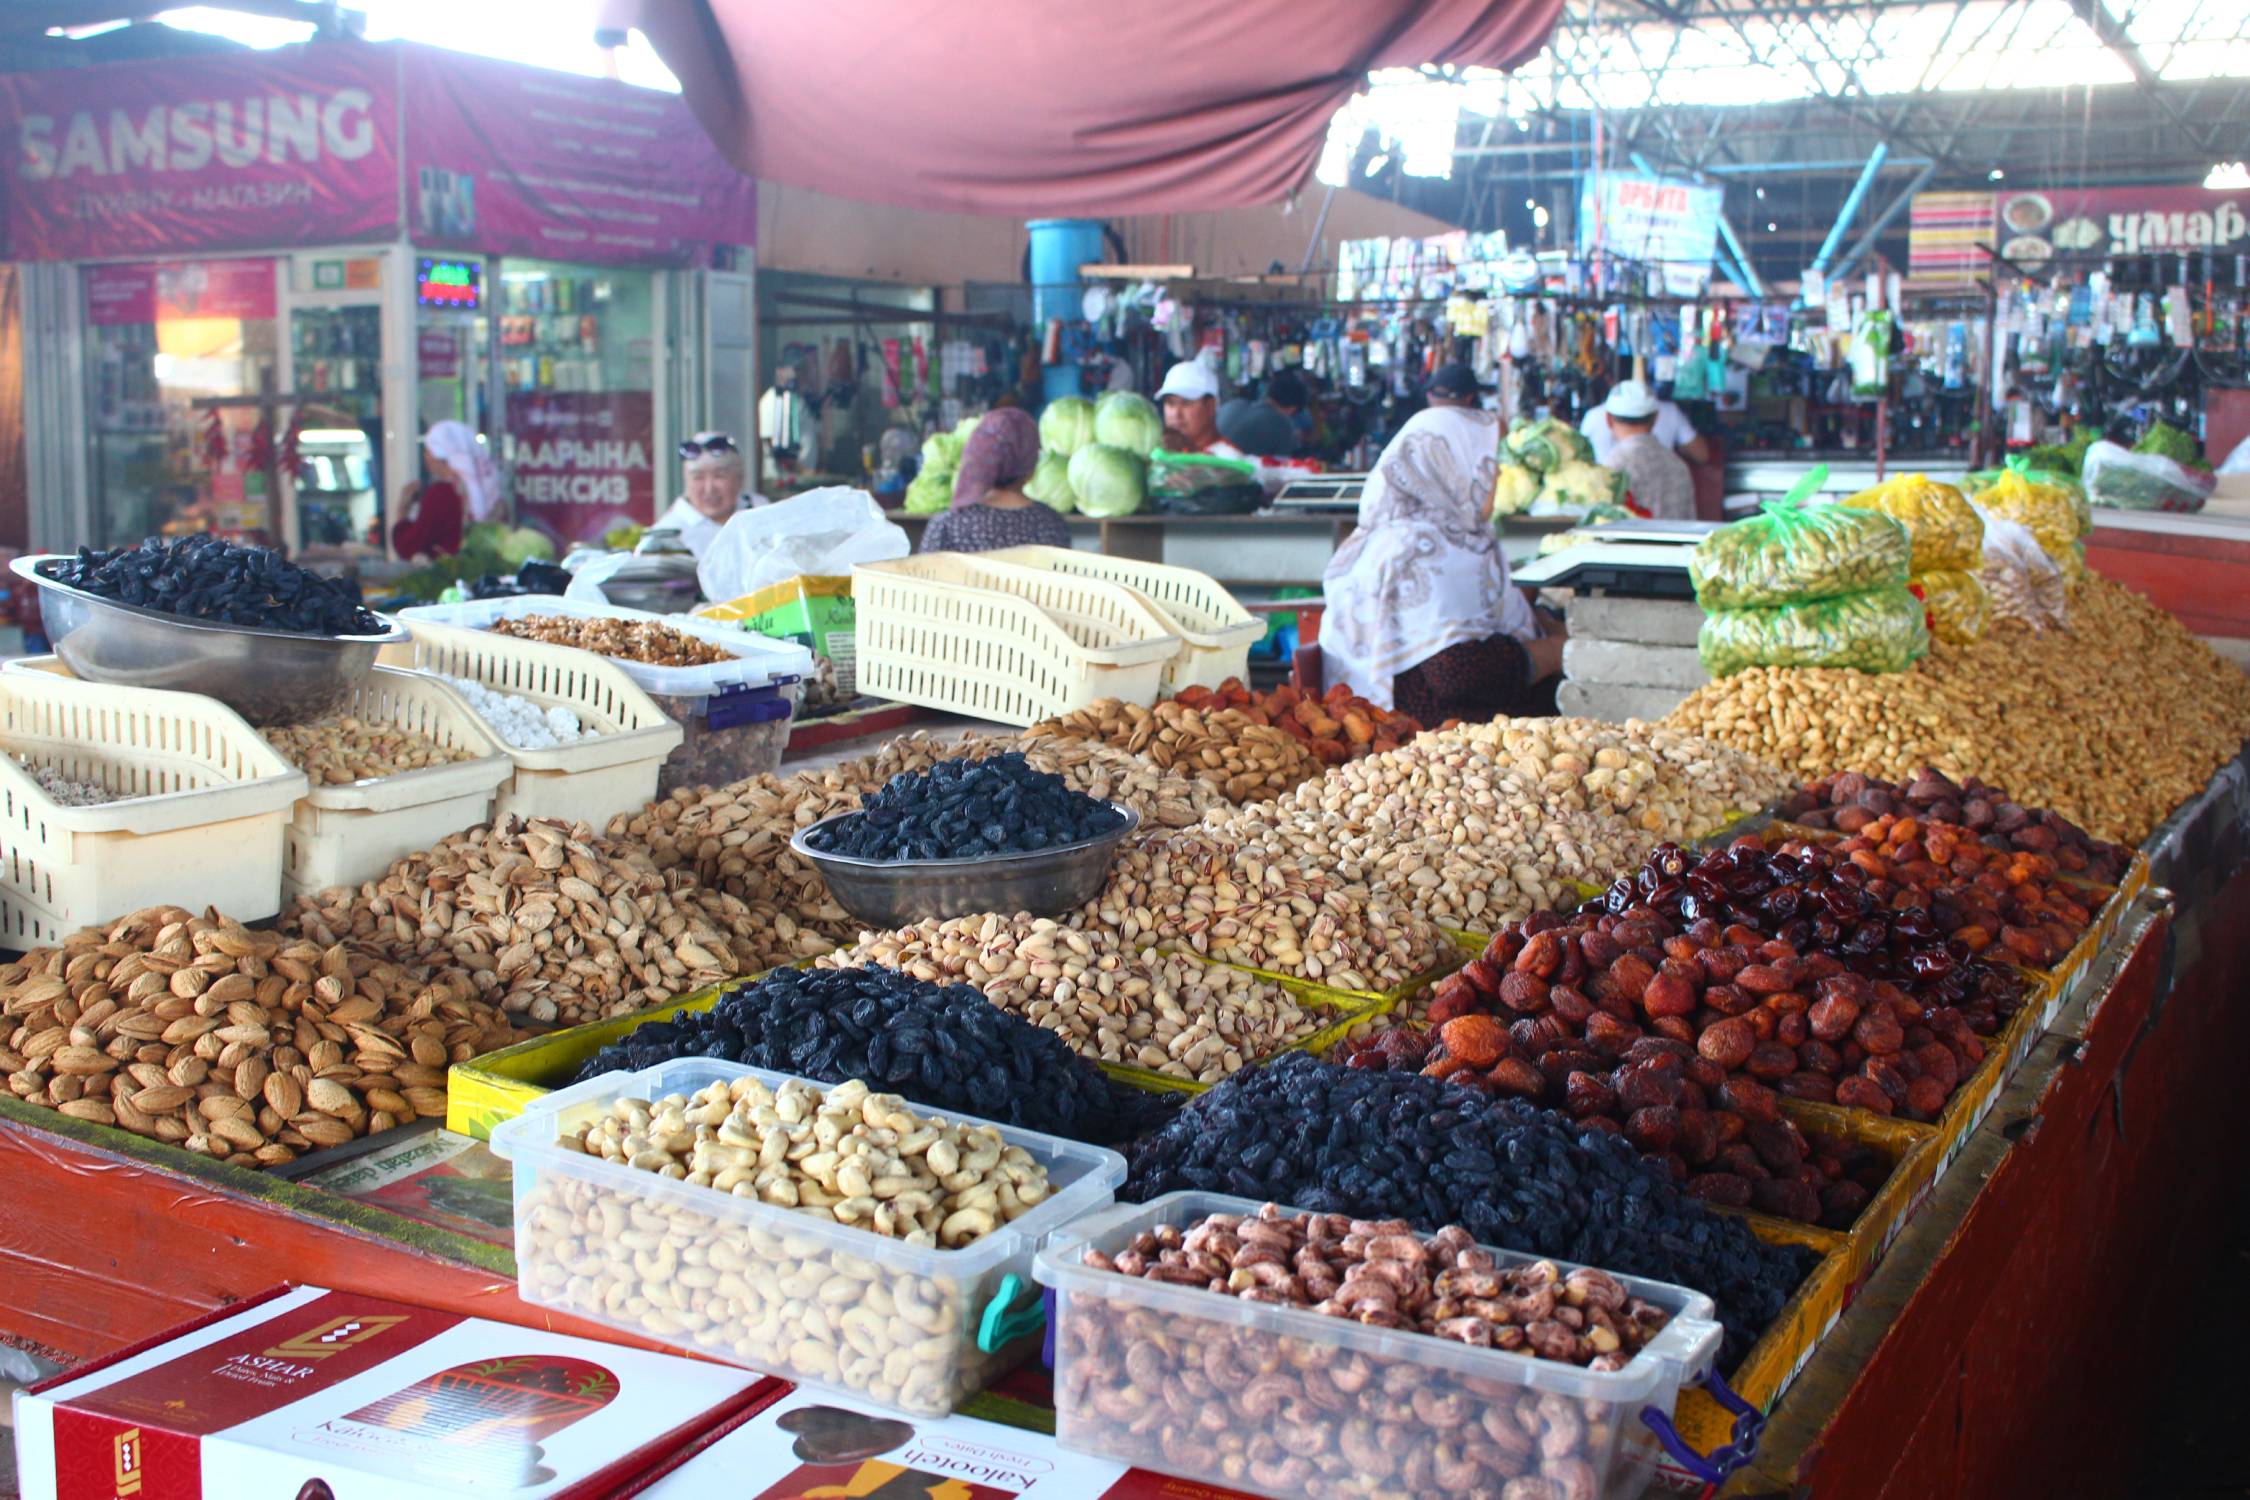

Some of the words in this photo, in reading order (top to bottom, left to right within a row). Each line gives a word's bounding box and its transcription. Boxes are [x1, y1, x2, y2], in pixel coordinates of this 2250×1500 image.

[19, 88, 375, 181] SAMSUNG
[192, 181, 312, 209] МАГАЗИН
[511, 439, 647, 471] ААРЫНА
[514, 473, 630, 505] ЧЕКСИЗ
[227, 1353, 315, 1378] ASHAR
